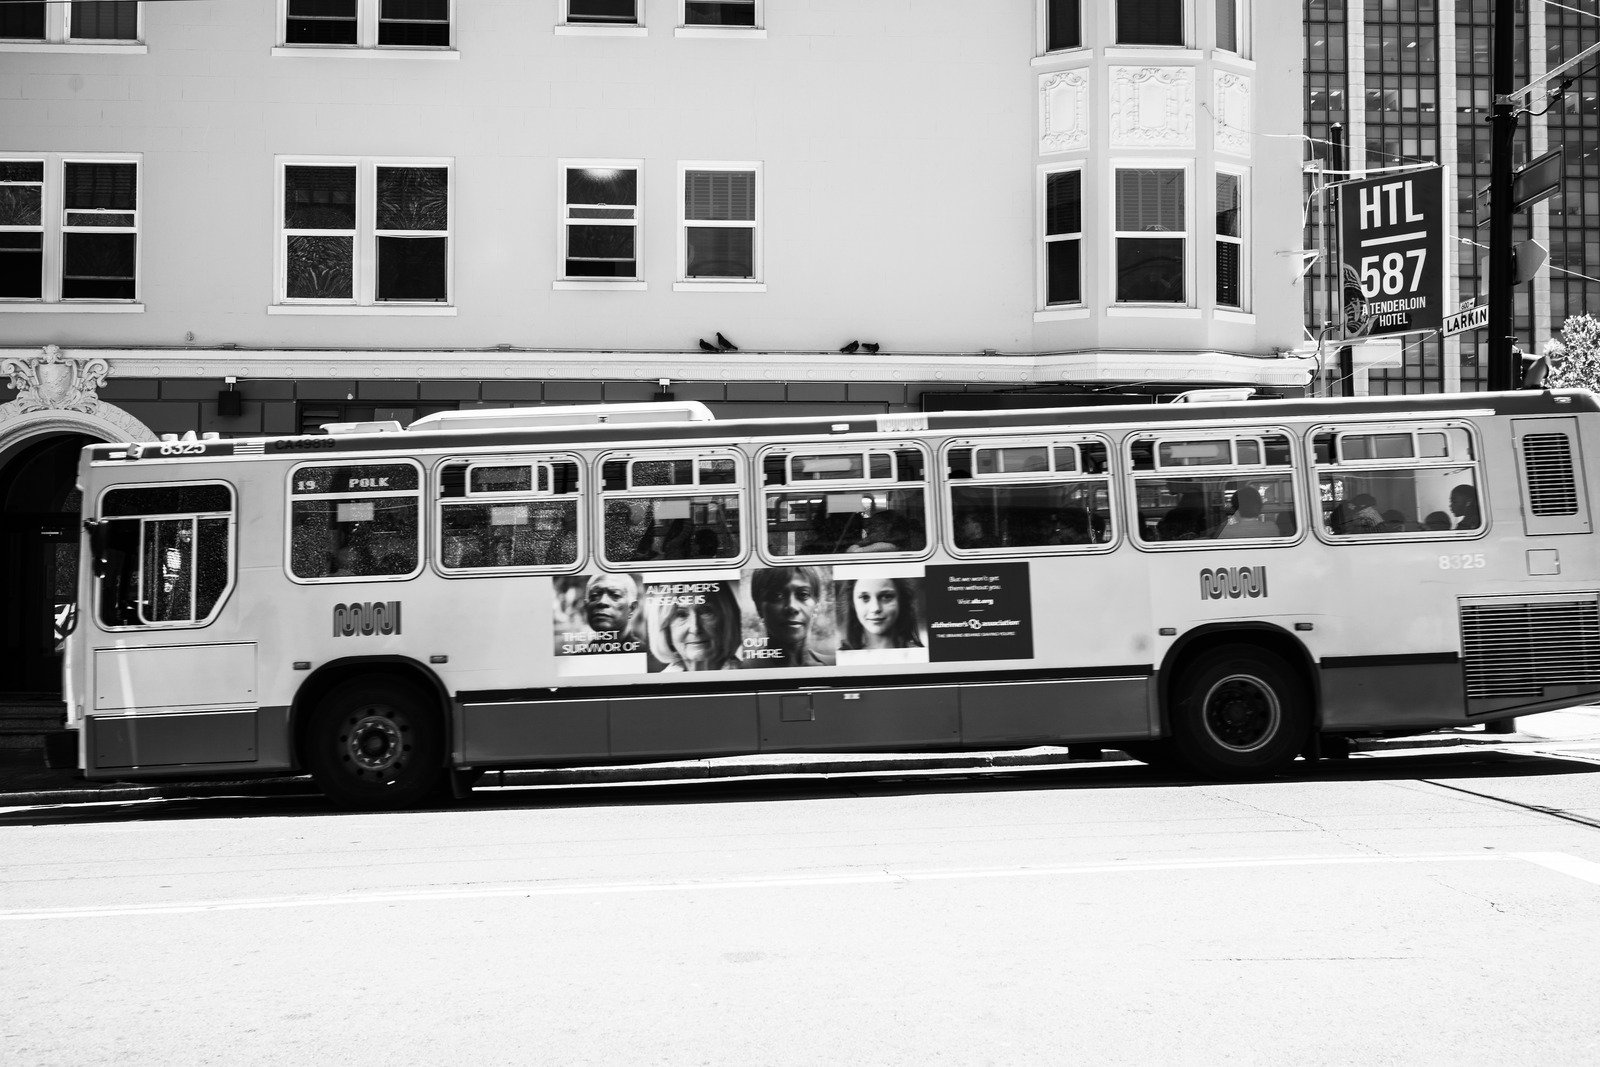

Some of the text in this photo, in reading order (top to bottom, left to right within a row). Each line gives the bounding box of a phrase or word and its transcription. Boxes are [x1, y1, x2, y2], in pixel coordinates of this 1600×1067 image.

[1360, 180, 1424, 229] HTL
[1360, 248, 1427, 298] 587
[1361, 296, 1426, 316] A TENDERLOIN
[1379, 312, 1409, 327] HOTEL
[1446, 308, 1487, 333] LARKIN
[160, 442, 206, 455] 8325
[297, 477, 390, 491] 19 POLK
[1438, 553, 1486, 570] 8325
[646, 582, 721, 595] ALZHEIMER'S
[694, 594, 706, 605] IS
[561, 630, 620, 642] THE FIRST
[743, 636, 770, 648] OUT
[561, 641, 641, 654] SURVIVOR OF
